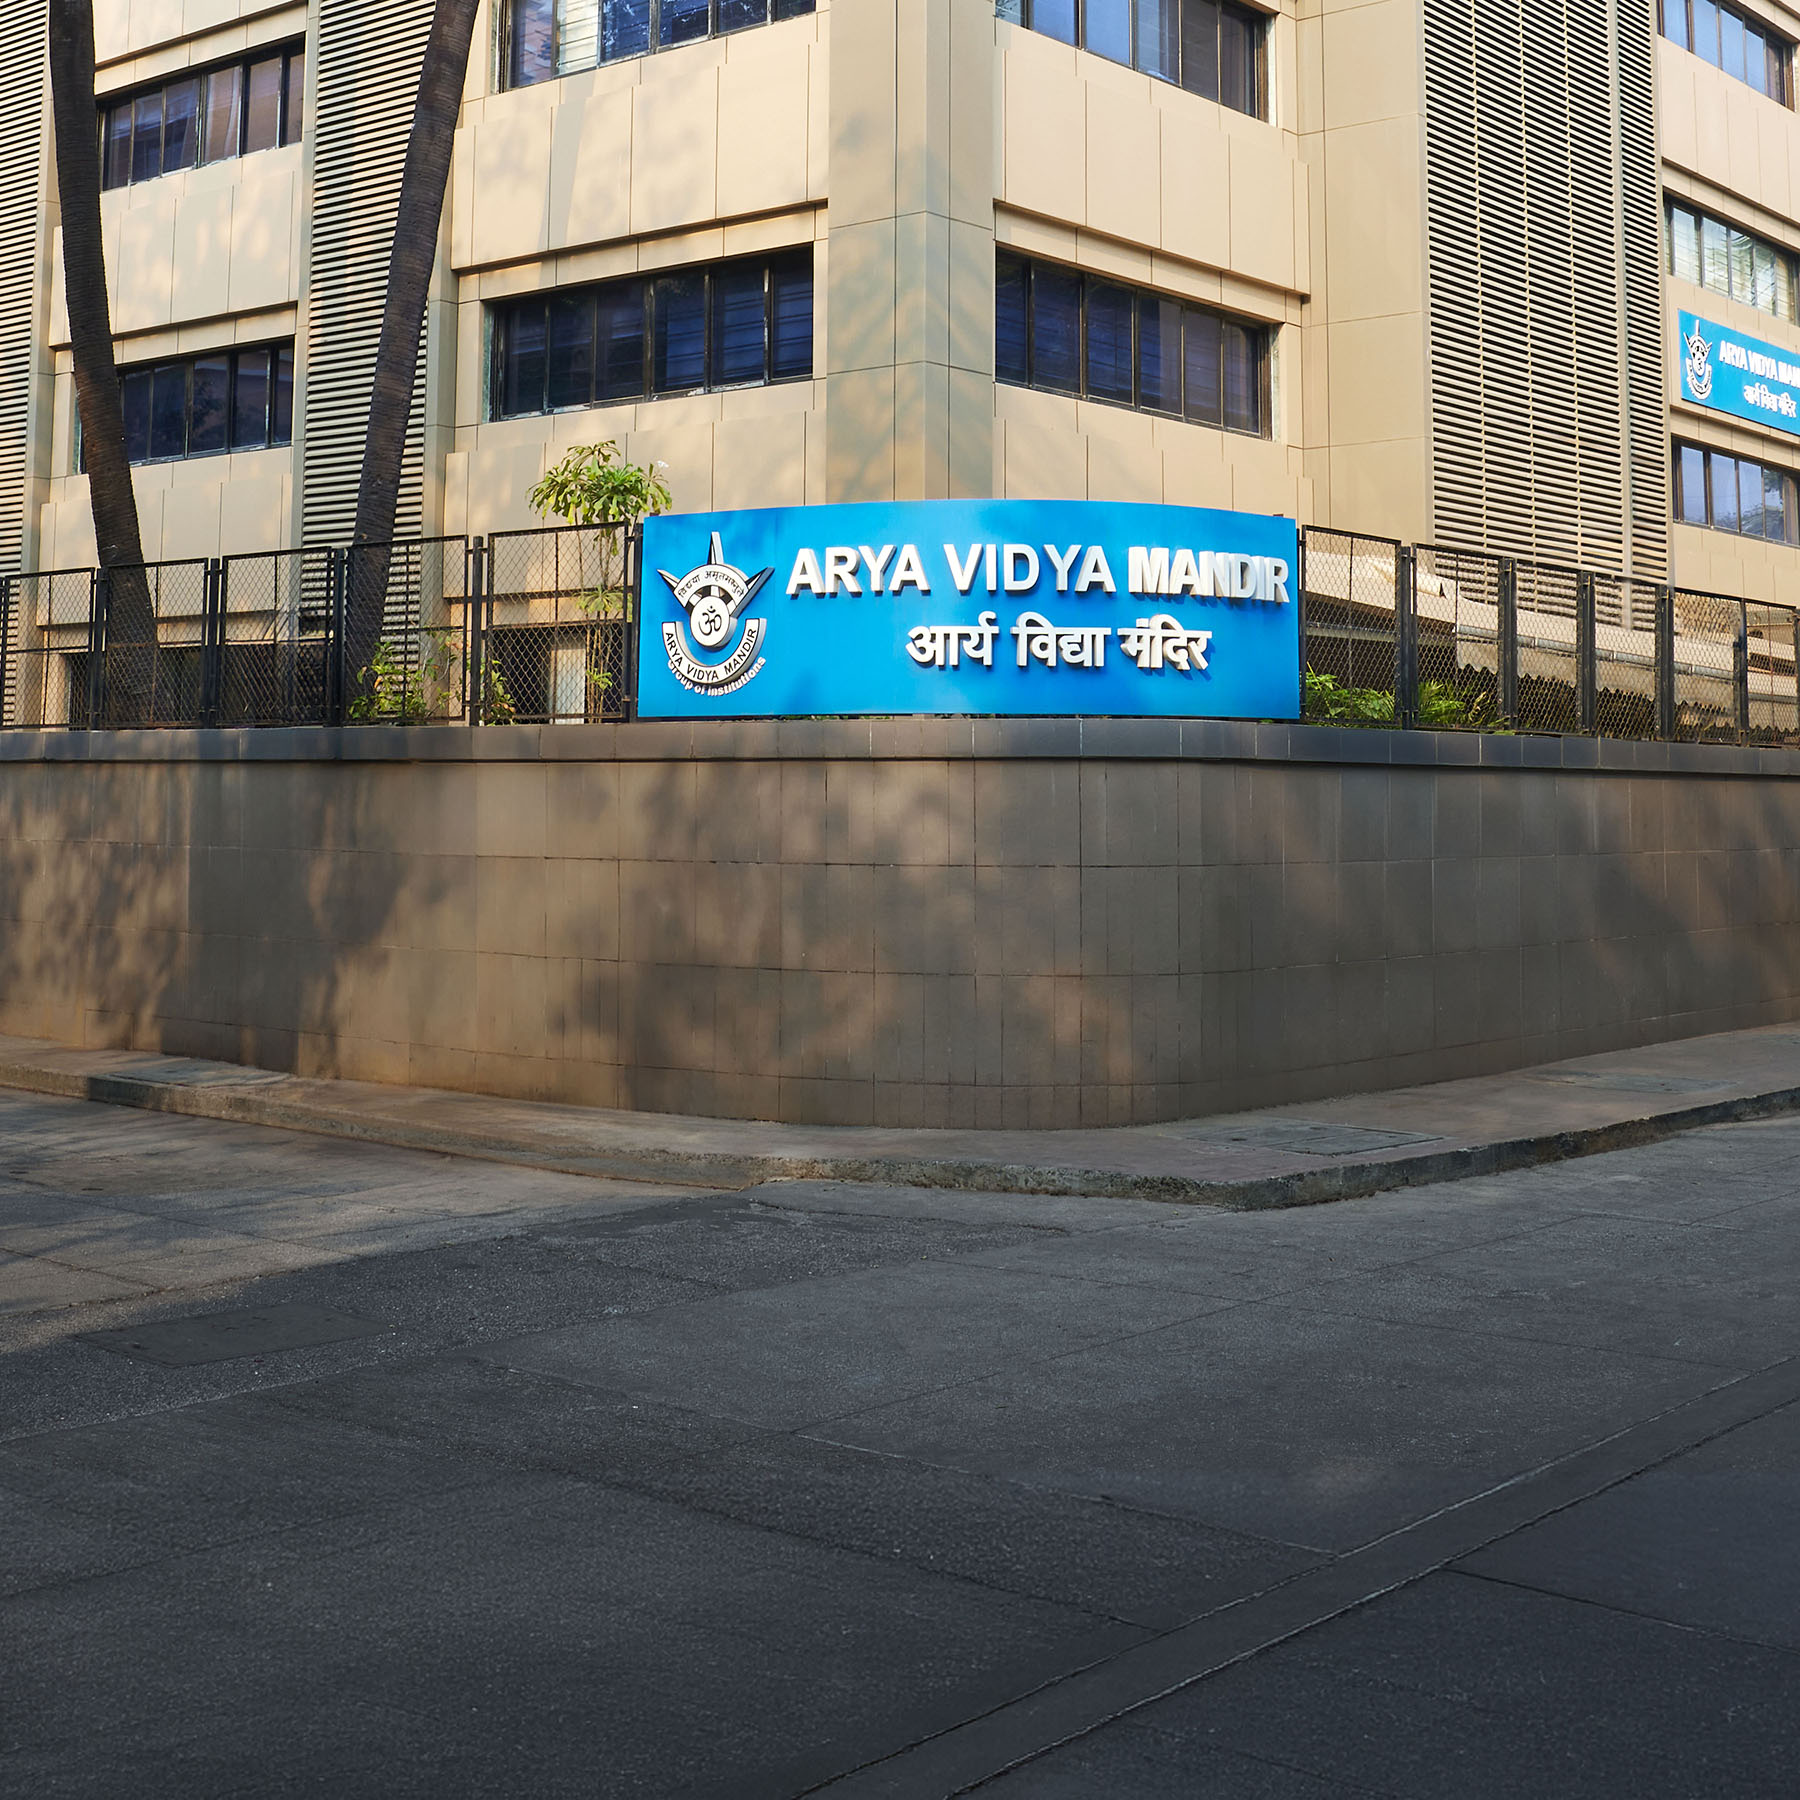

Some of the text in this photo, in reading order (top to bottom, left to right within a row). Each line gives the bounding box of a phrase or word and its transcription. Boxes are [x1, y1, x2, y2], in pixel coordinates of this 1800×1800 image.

[1719, 340, 1749, 371] ARYA
[1747, 350, 1778, 381] VIDYA
[786, 544, 1290, 603] ARYA VIDYA MANDIR
[665, 628, 757, 681] ARYA VIDYA MANDIR
[905, 611, 1213, 670] आर्य विद्या मंदिर
